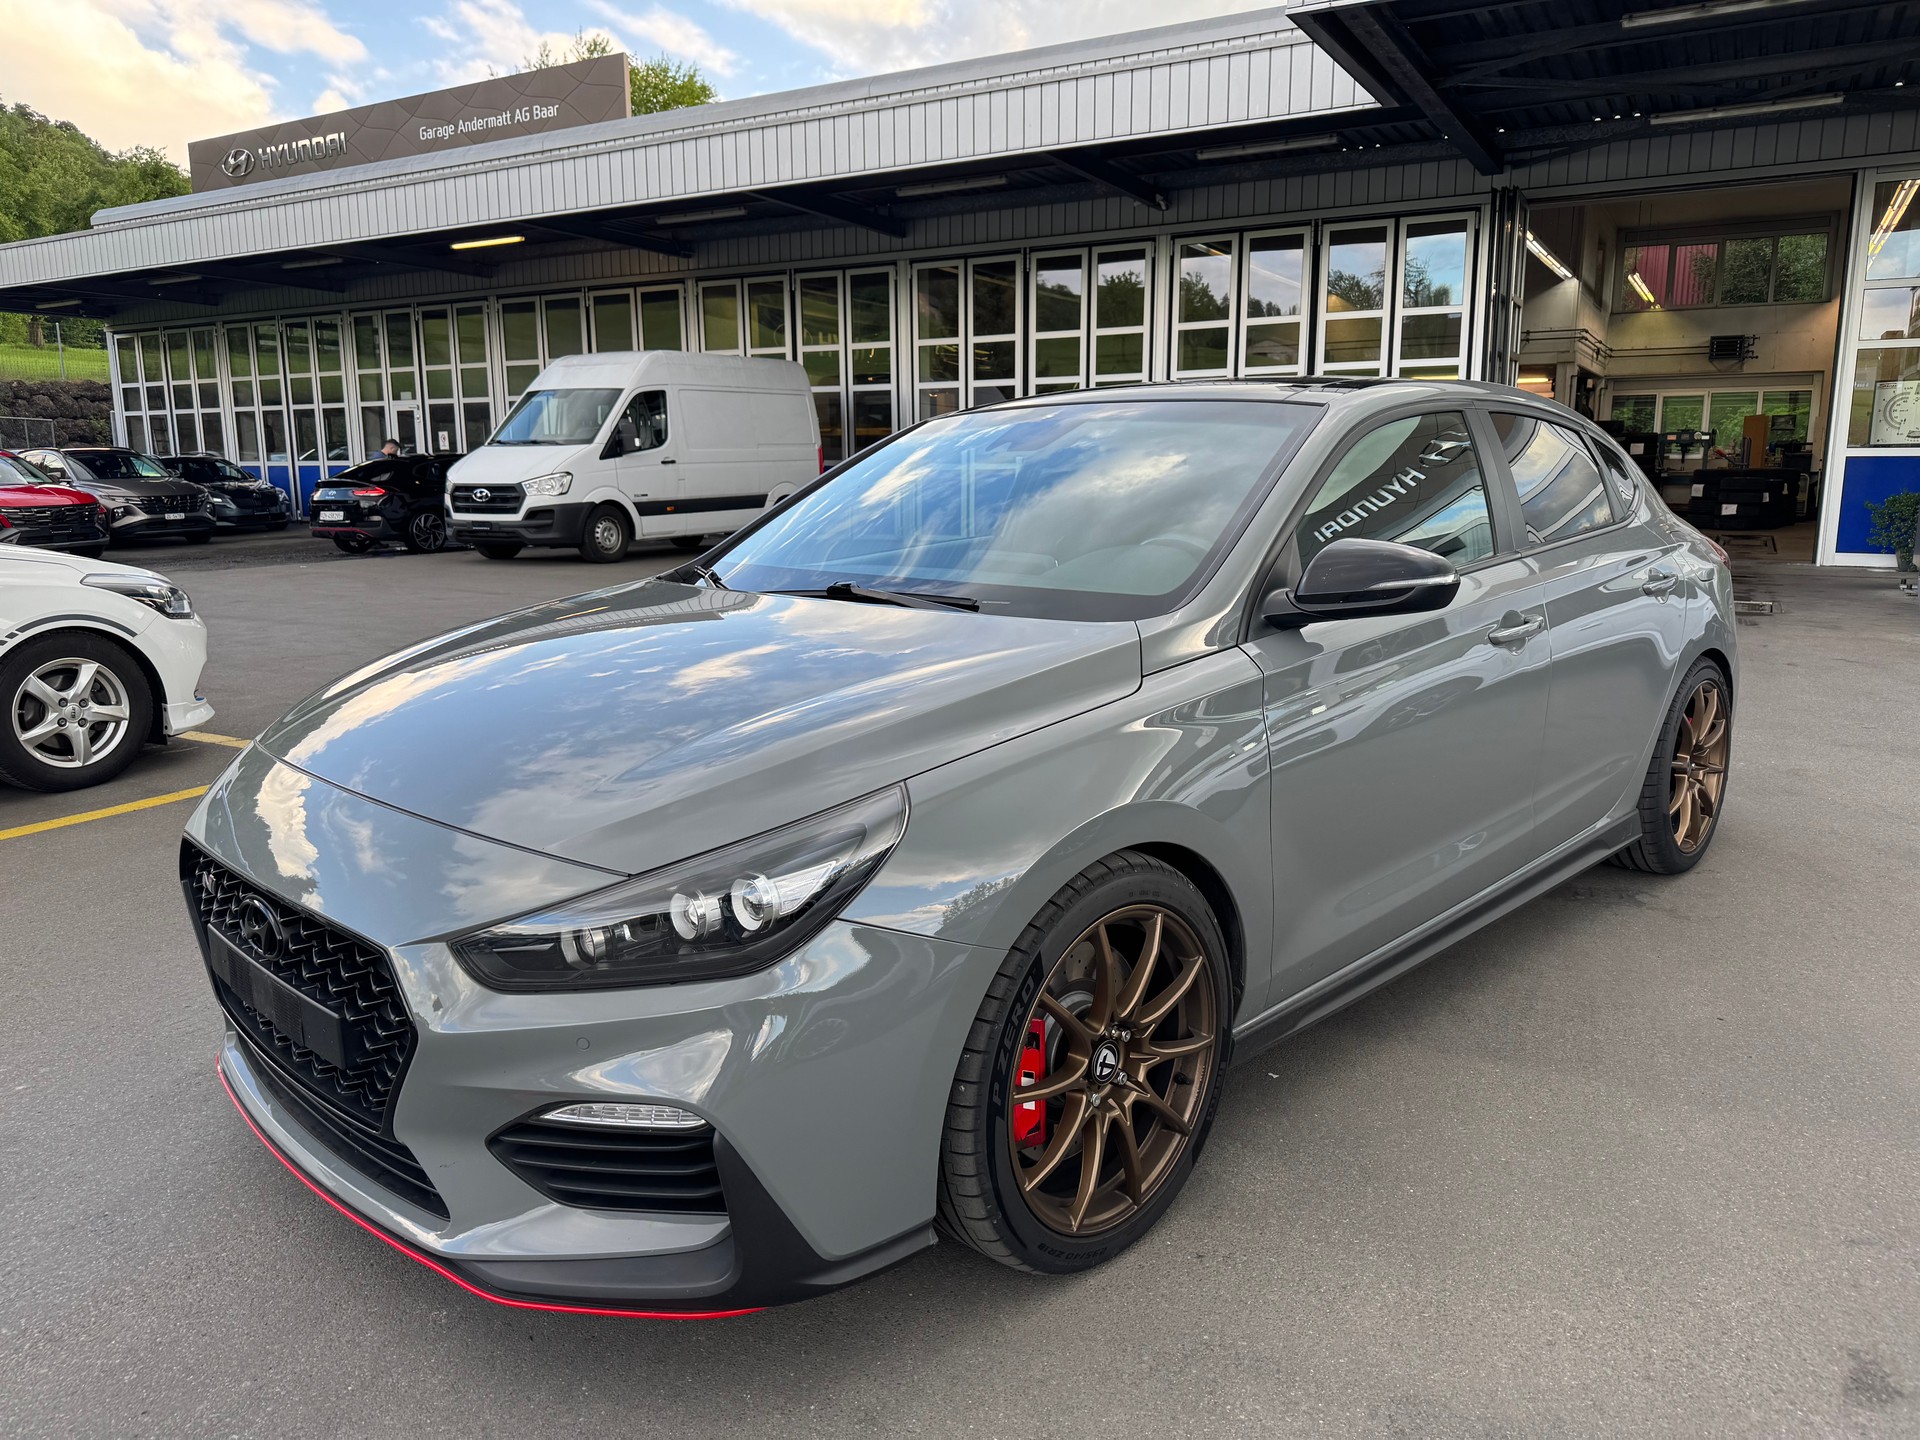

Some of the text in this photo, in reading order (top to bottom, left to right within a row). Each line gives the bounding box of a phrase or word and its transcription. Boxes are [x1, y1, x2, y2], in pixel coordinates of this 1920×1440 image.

[419, 104, 559, 141] Garage Andermatt AG Baar
[258, 131, 348, 170] HYUNDAI
[997, 975, 1035, 1075] ZERO
